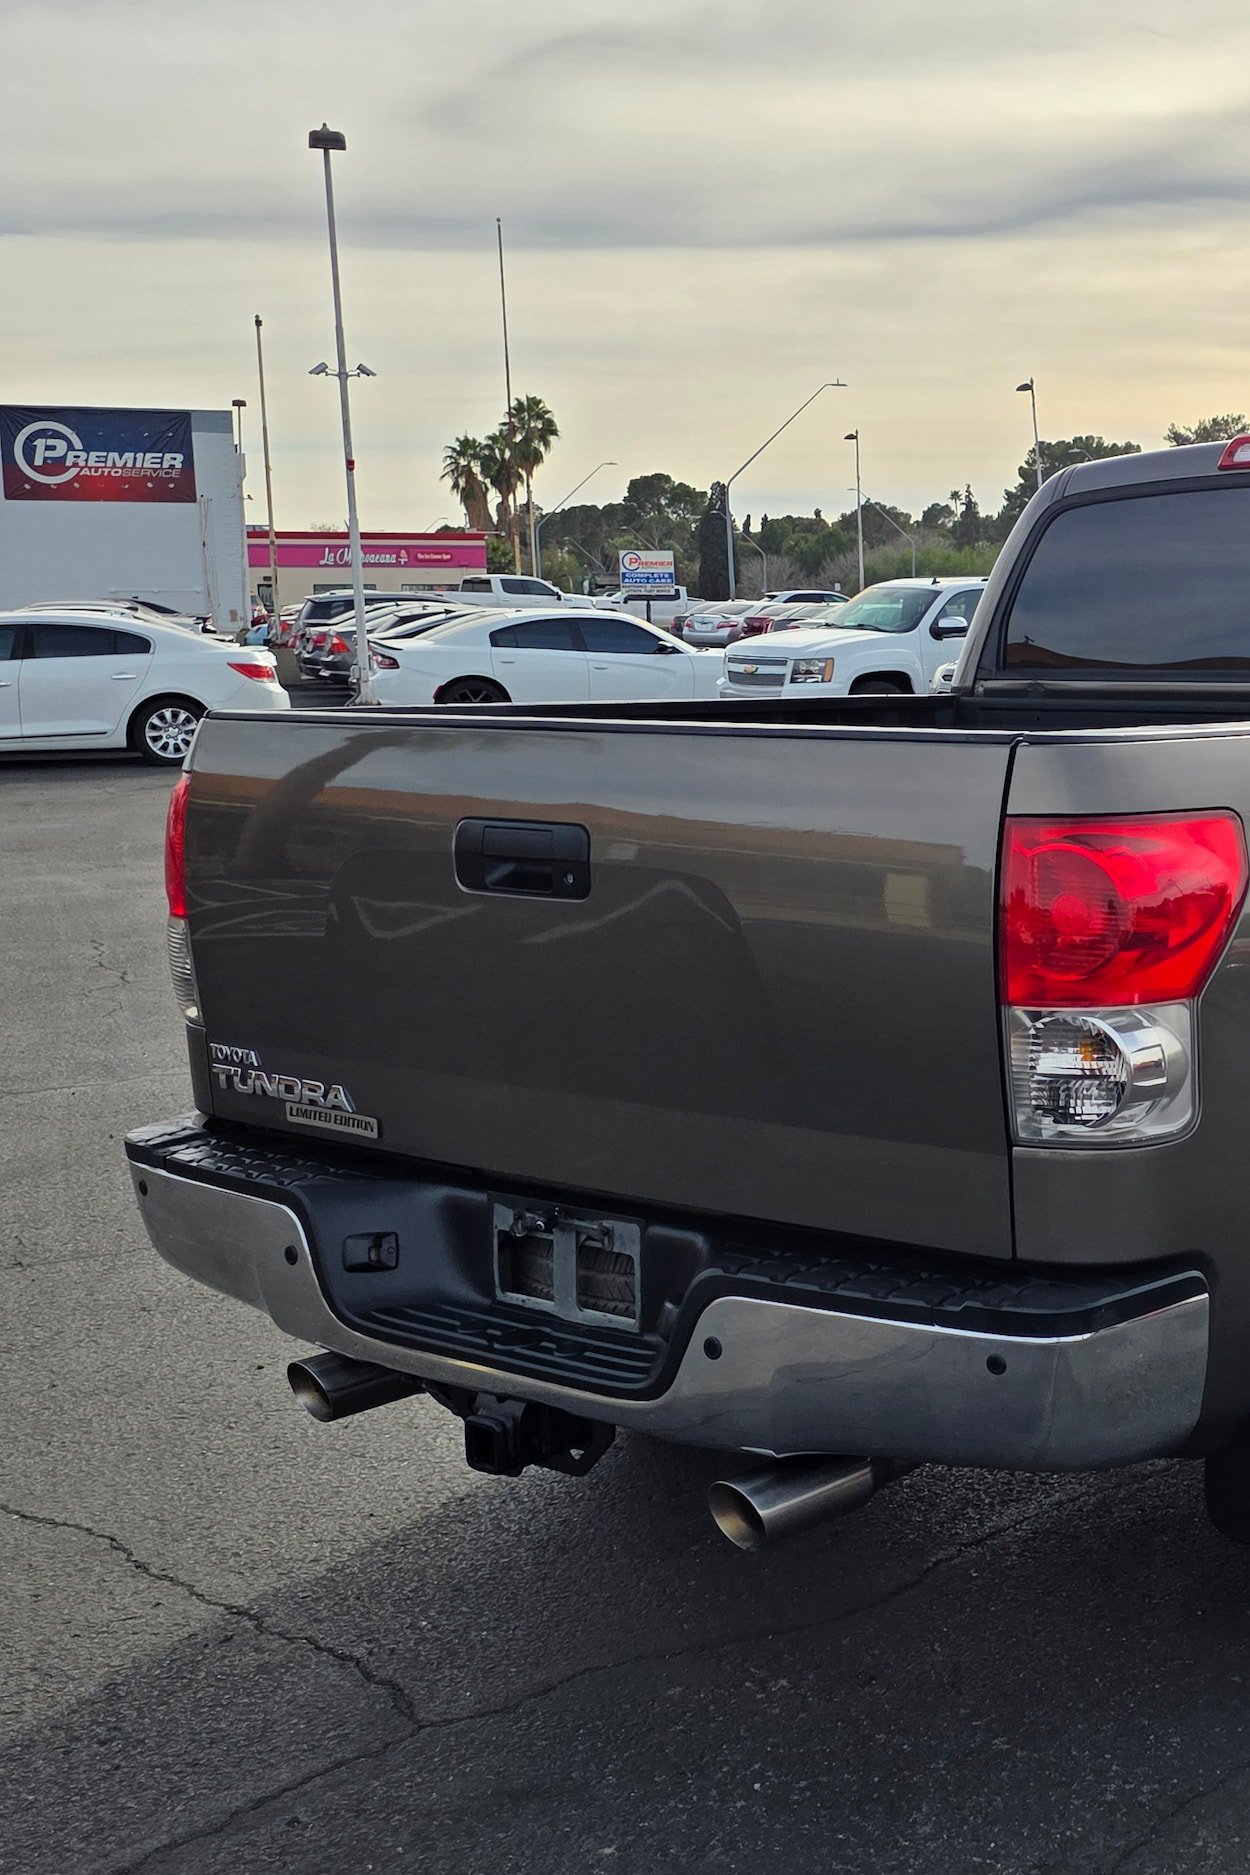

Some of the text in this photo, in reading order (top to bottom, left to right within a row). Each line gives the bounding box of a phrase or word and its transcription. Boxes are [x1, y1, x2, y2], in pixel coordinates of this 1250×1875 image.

[209, 1043, 262, 1067] TOYOTA
[211, 1063, 357, 1113] TUNDRA
[289, 1106, 375, 1133] LIMITED EDITION
